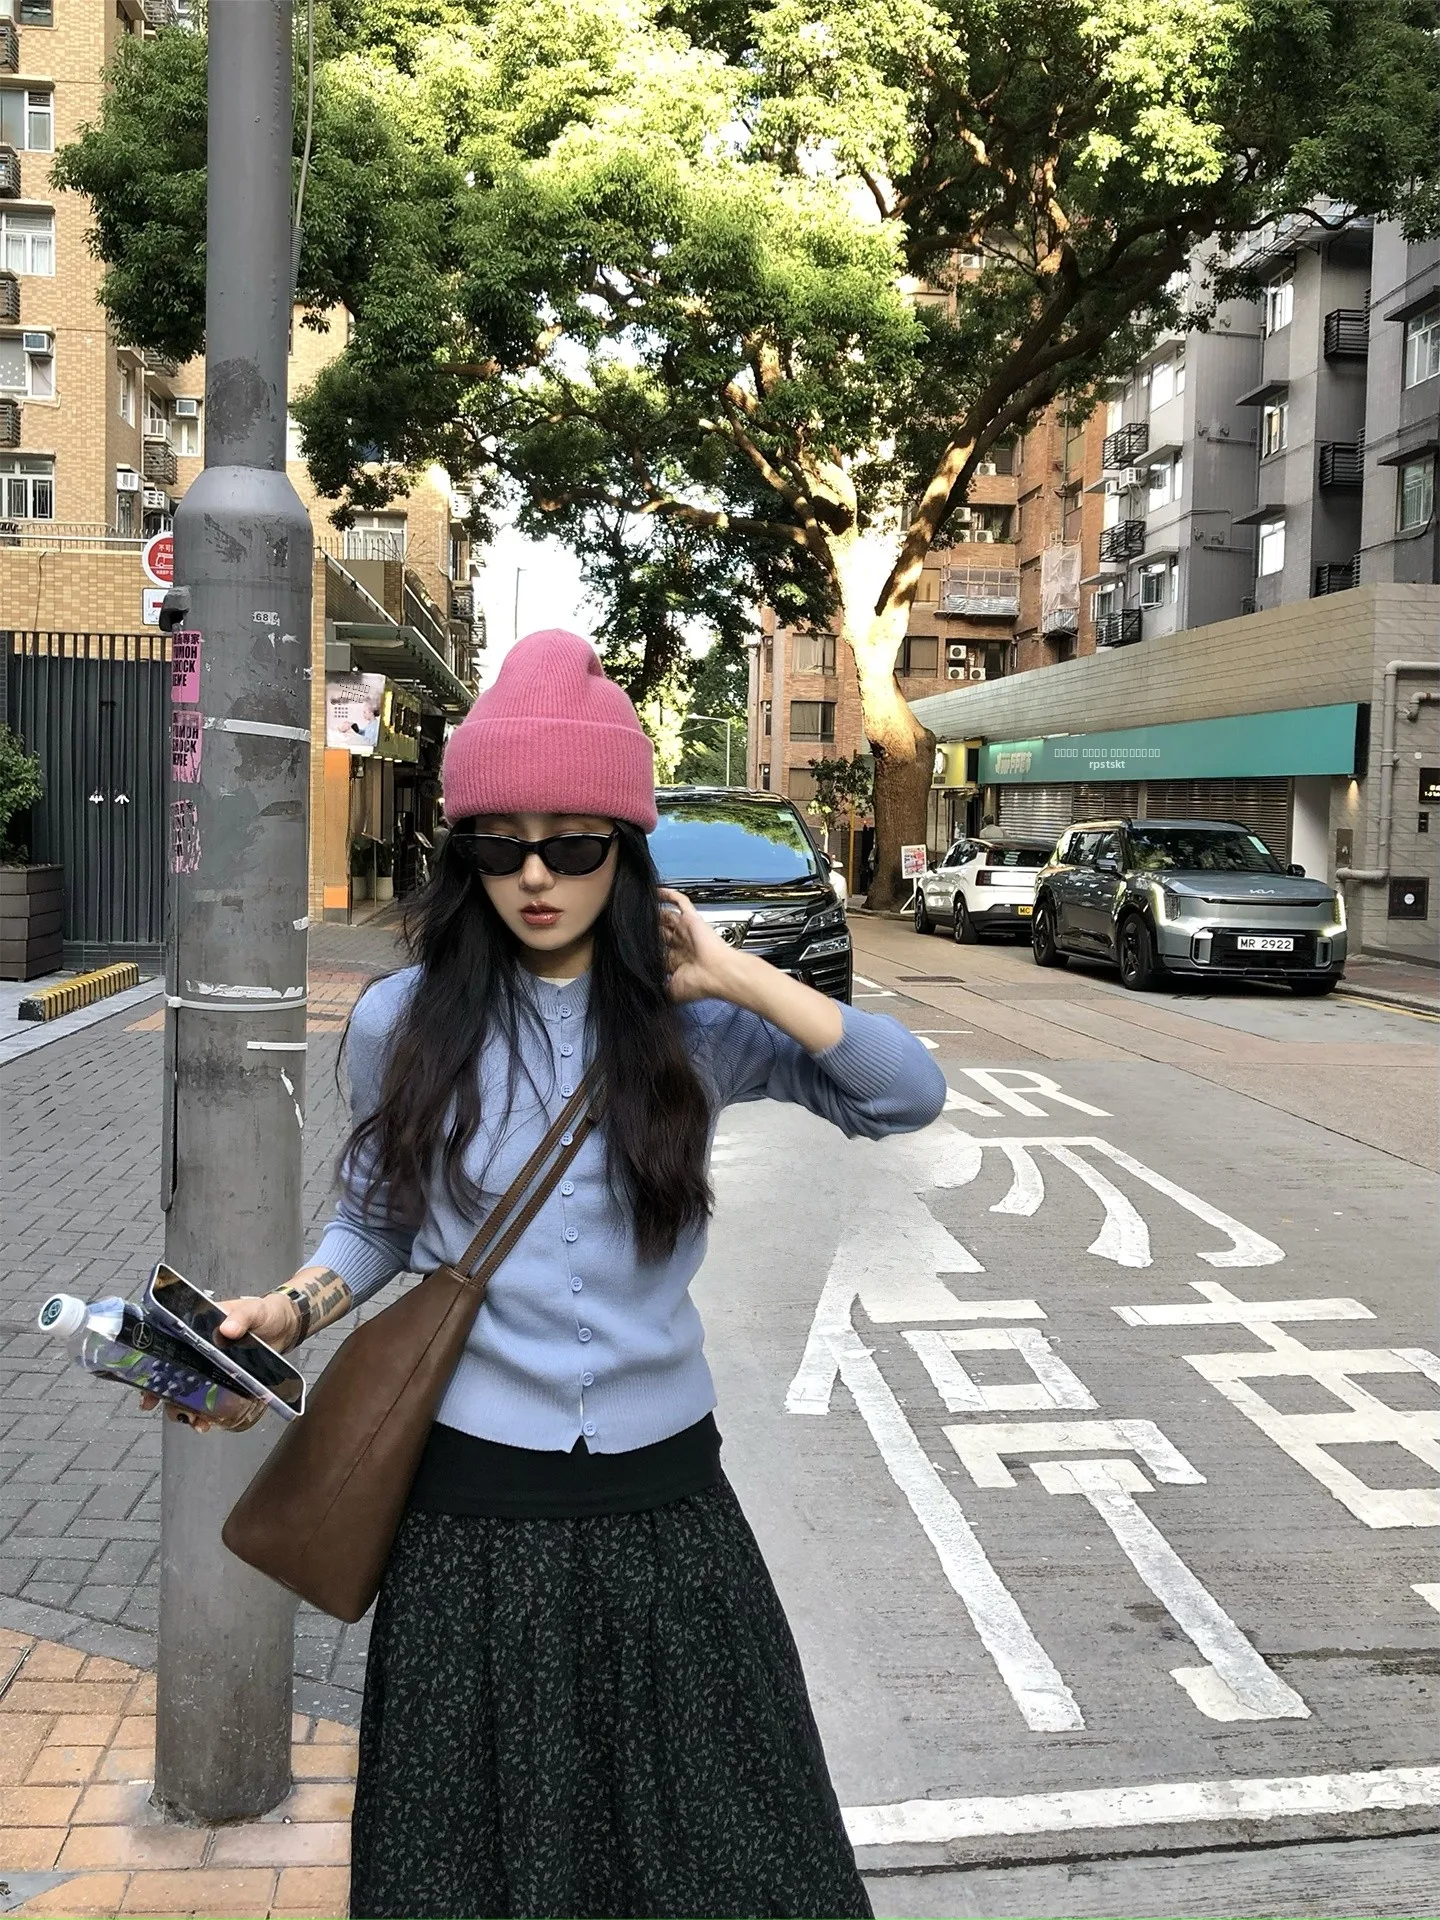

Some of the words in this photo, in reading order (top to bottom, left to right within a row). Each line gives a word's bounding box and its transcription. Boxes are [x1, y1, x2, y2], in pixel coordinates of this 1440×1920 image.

[158, 543, 173, 552] 不可
[1089, 759, 1126, 771] rpstskt
[1240, 938, 1256, 948] MR
[1261, 939, 1292, 950] 2922
